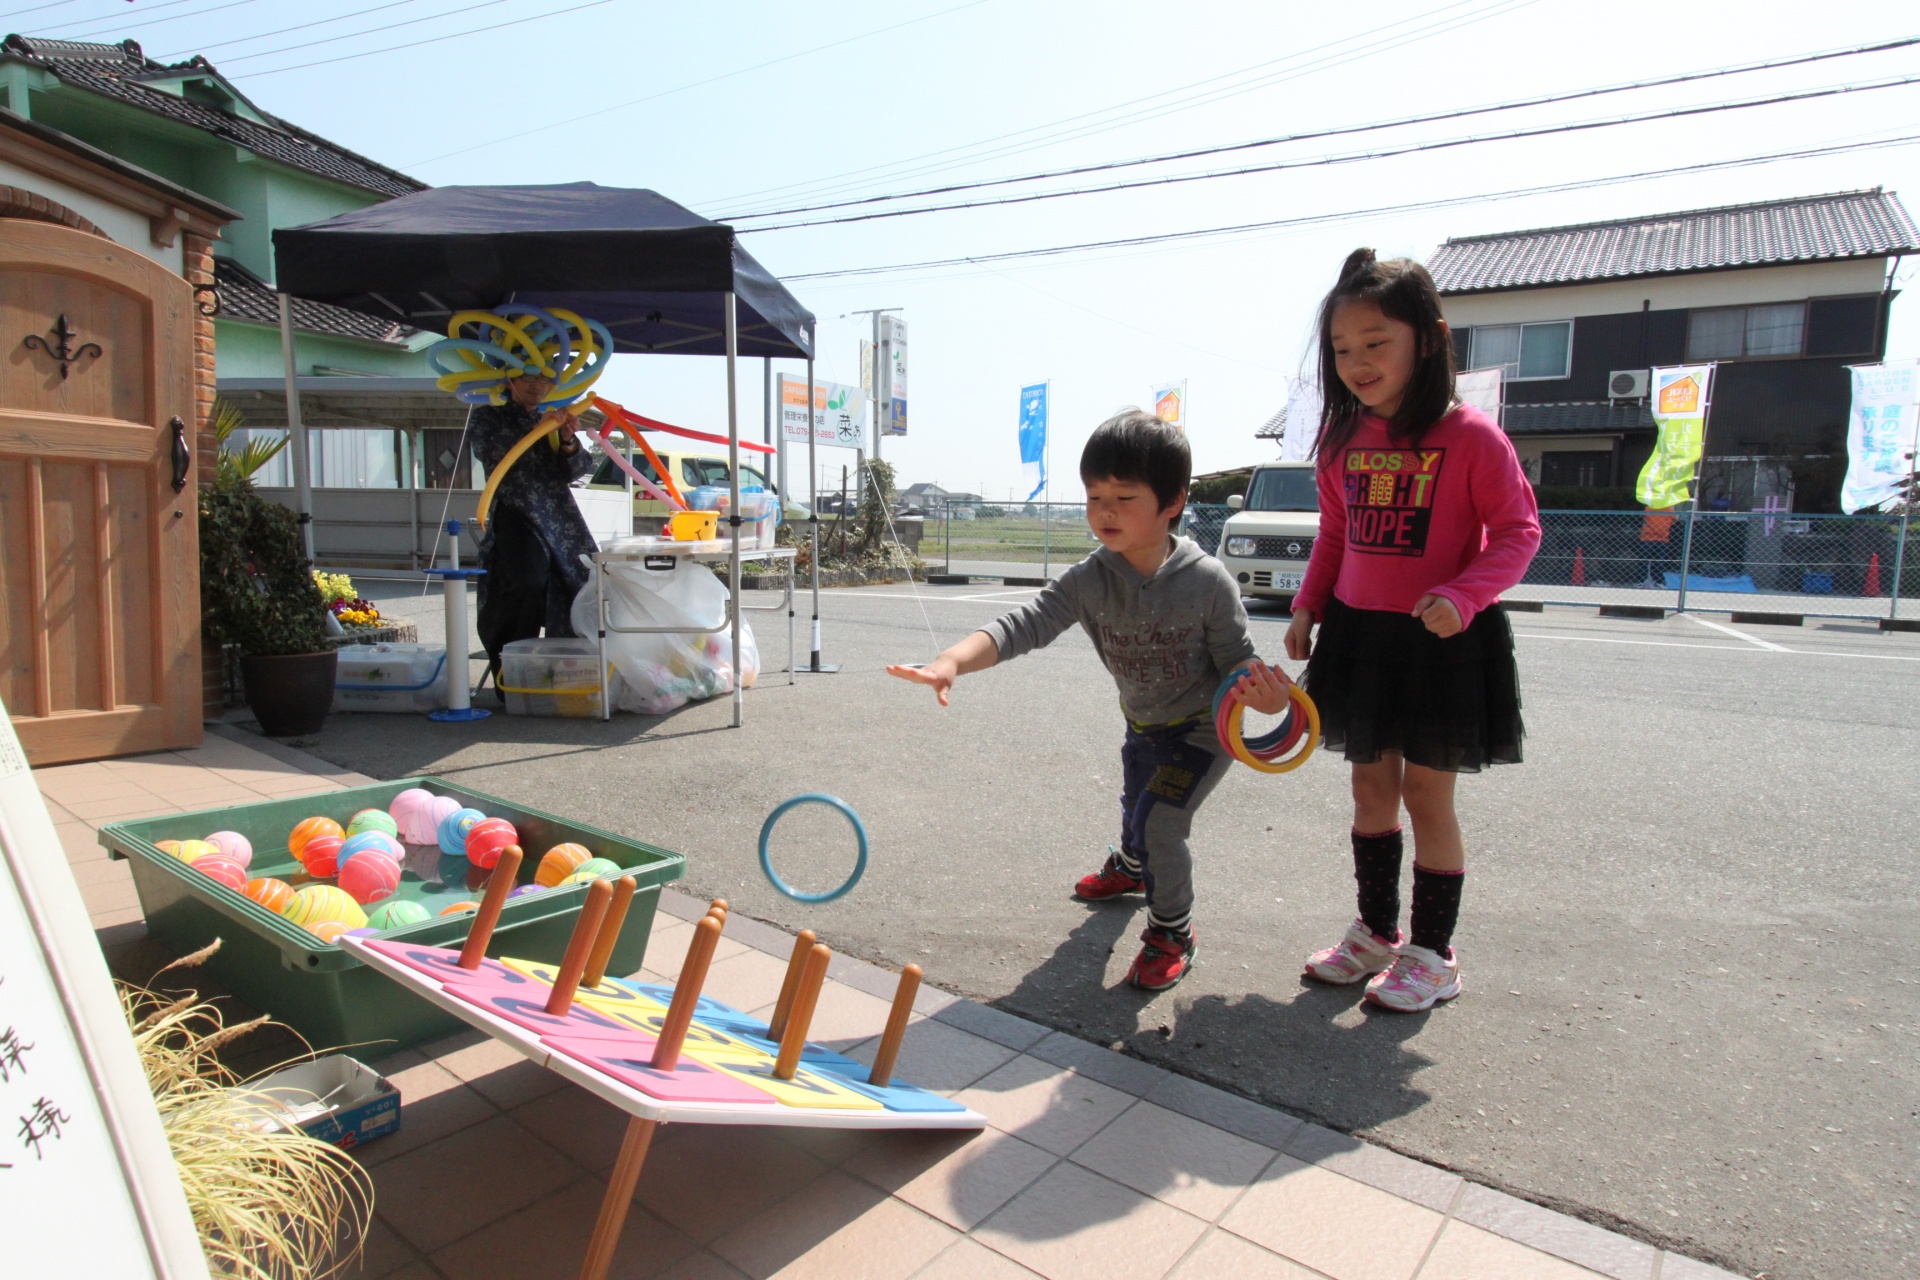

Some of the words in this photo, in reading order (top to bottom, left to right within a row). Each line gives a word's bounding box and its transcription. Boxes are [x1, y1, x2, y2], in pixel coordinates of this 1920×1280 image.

[1857, 376, 1910, 387] GARDEN
[1858, 368, 1912, 380] REFORM
[784, 410, 825, 425] 管理栄養の店
[1347, 452, 1439, 471] GLOSSY
[1345, 473, 1433, 507] BRIGHT
[1350, 508, 1416, 545] HOPE
[1280, 579, 1300, 589] 58-9
[1101, 625, 1131, 647] The
